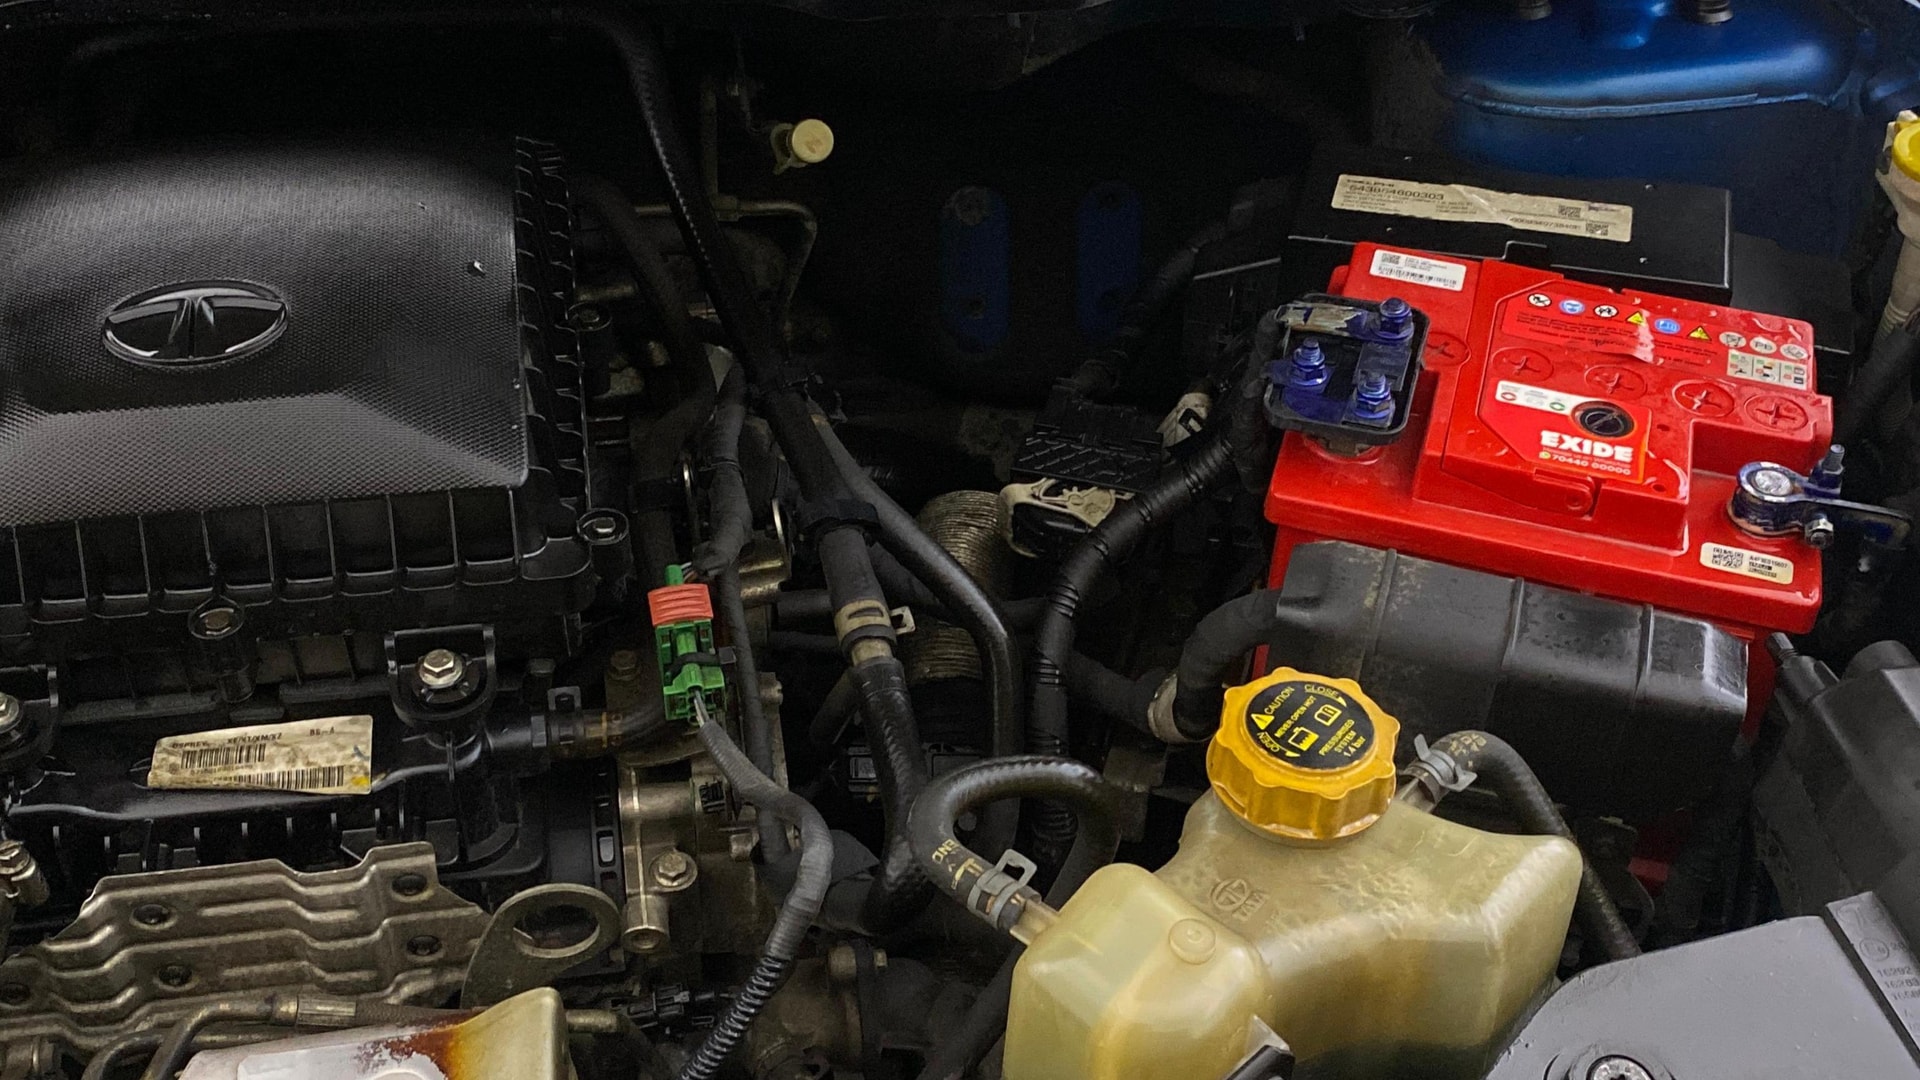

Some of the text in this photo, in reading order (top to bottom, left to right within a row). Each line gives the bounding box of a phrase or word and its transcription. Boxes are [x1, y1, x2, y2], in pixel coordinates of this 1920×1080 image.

[1540, 430, 1634, 462] EXIDE
[1551, 454, 1589, 467] 70440
[1591, 462, 1632, 475] 00000
[1264, 686, 1295, 714] CAUTION
[1304, 684, 1339, 697] CLOSE
[1274, 695, 1317, 738] NEVER OPEN HOT
[1257, 732, 1281, 753] OPEN
[1334, 730, 1357, 753] SYSTEM
[1354, 736, 1366, 750] bar
